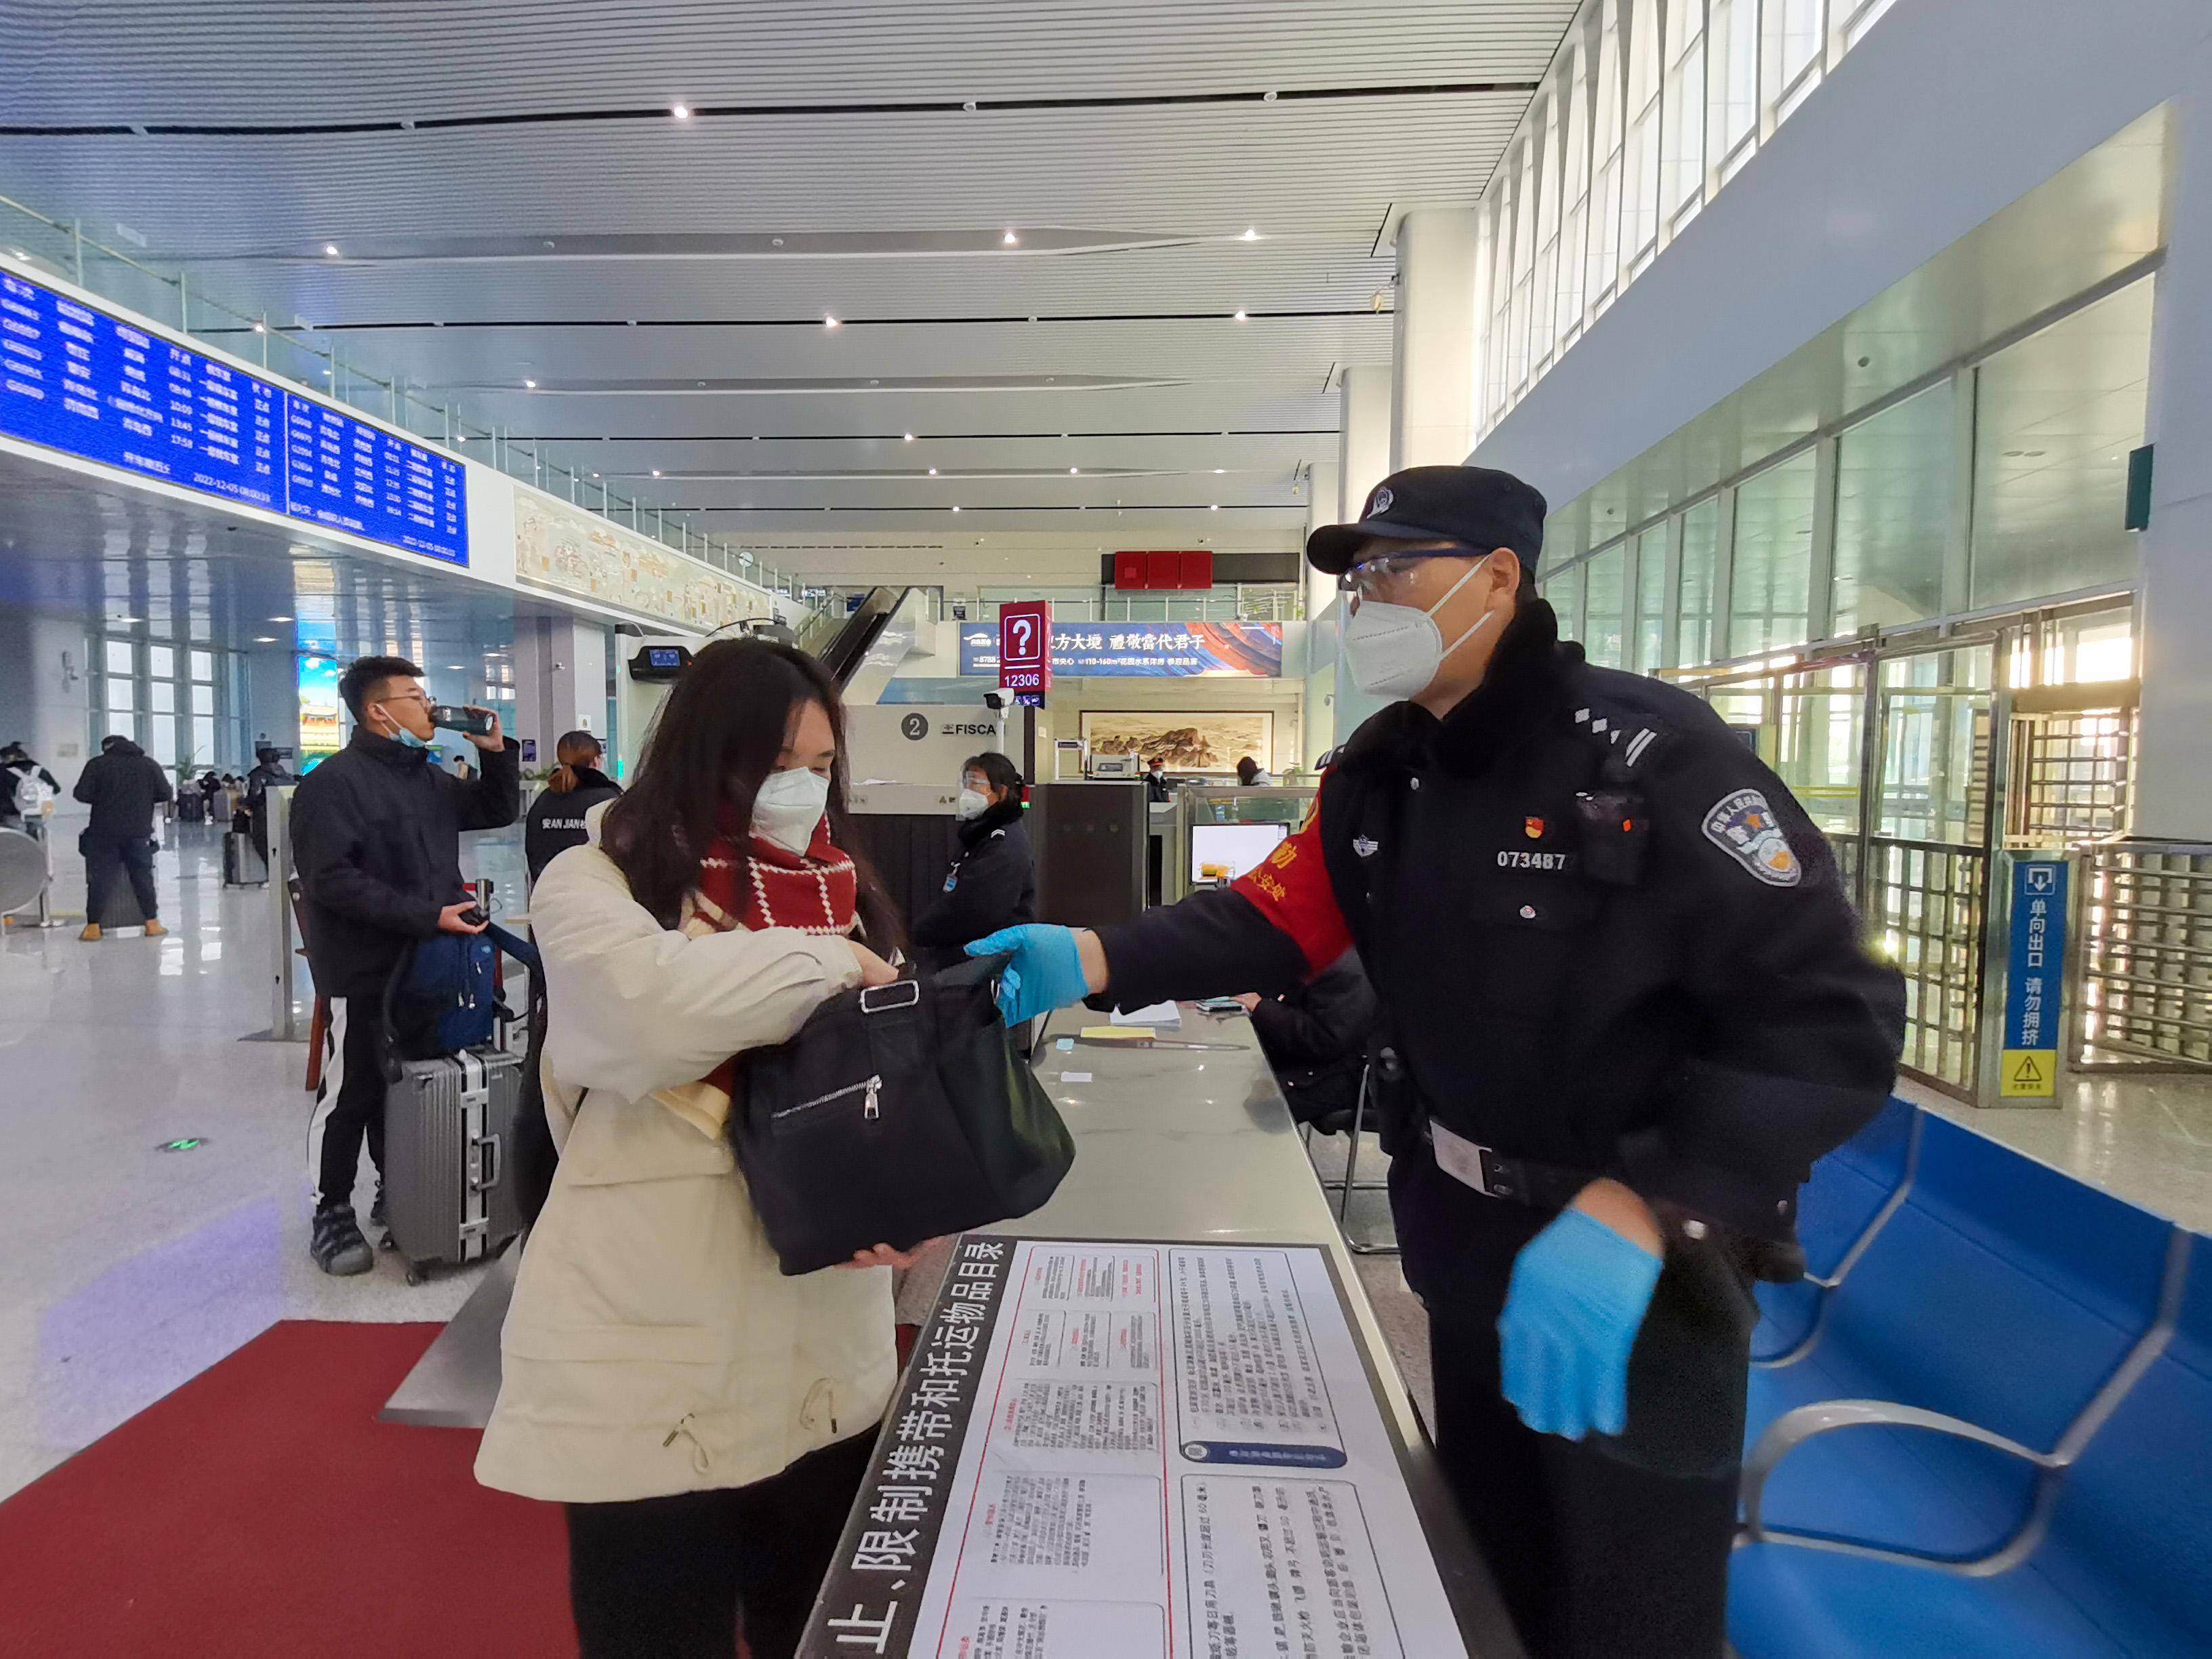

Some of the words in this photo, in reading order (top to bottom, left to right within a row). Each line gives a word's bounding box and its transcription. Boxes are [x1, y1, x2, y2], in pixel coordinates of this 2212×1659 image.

[1004, 674, 1040, 687] 12306
[909, 718, 920, 736] 2
[956, 723, 998, 735] FISCA
[1497, 851, 1565, 869] 073487
[2027, 899, 2047, 968] 单向出口
[2022, 977, 2043, 1046] 请勿拥挤
